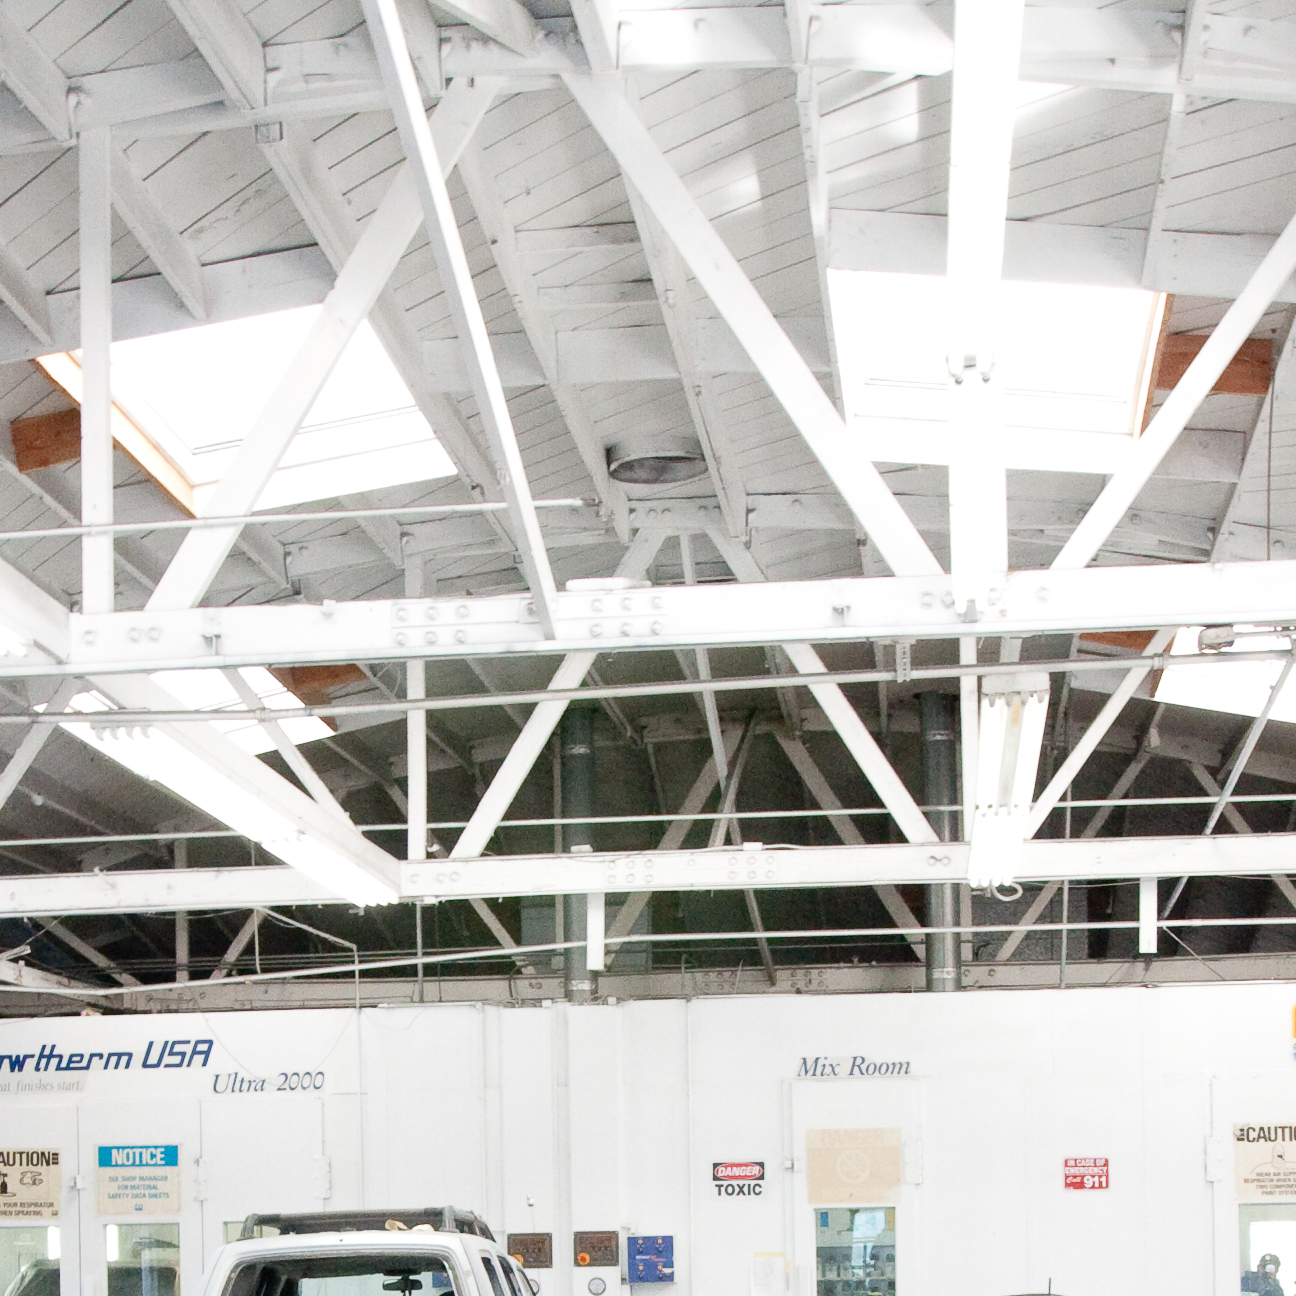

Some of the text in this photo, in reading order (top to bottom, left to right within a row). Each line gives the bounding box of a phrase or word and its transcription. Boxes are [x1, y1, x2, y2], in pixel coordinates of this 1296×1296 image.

[141, 1039, 214, 1069] USA
[797, 1055, 912, 1077] Mix Room
[15, 1079, 54, 1096] finishes
[212, 1071, 326, 1094] Ultra 2000
[111, 1148, 166, 1165] NOTICE
[717, 1166, 760, 1176] DANGER
[715, 1183, 762, 1196] TOXIC
[1084, 1176, 1106, 1188] 911
